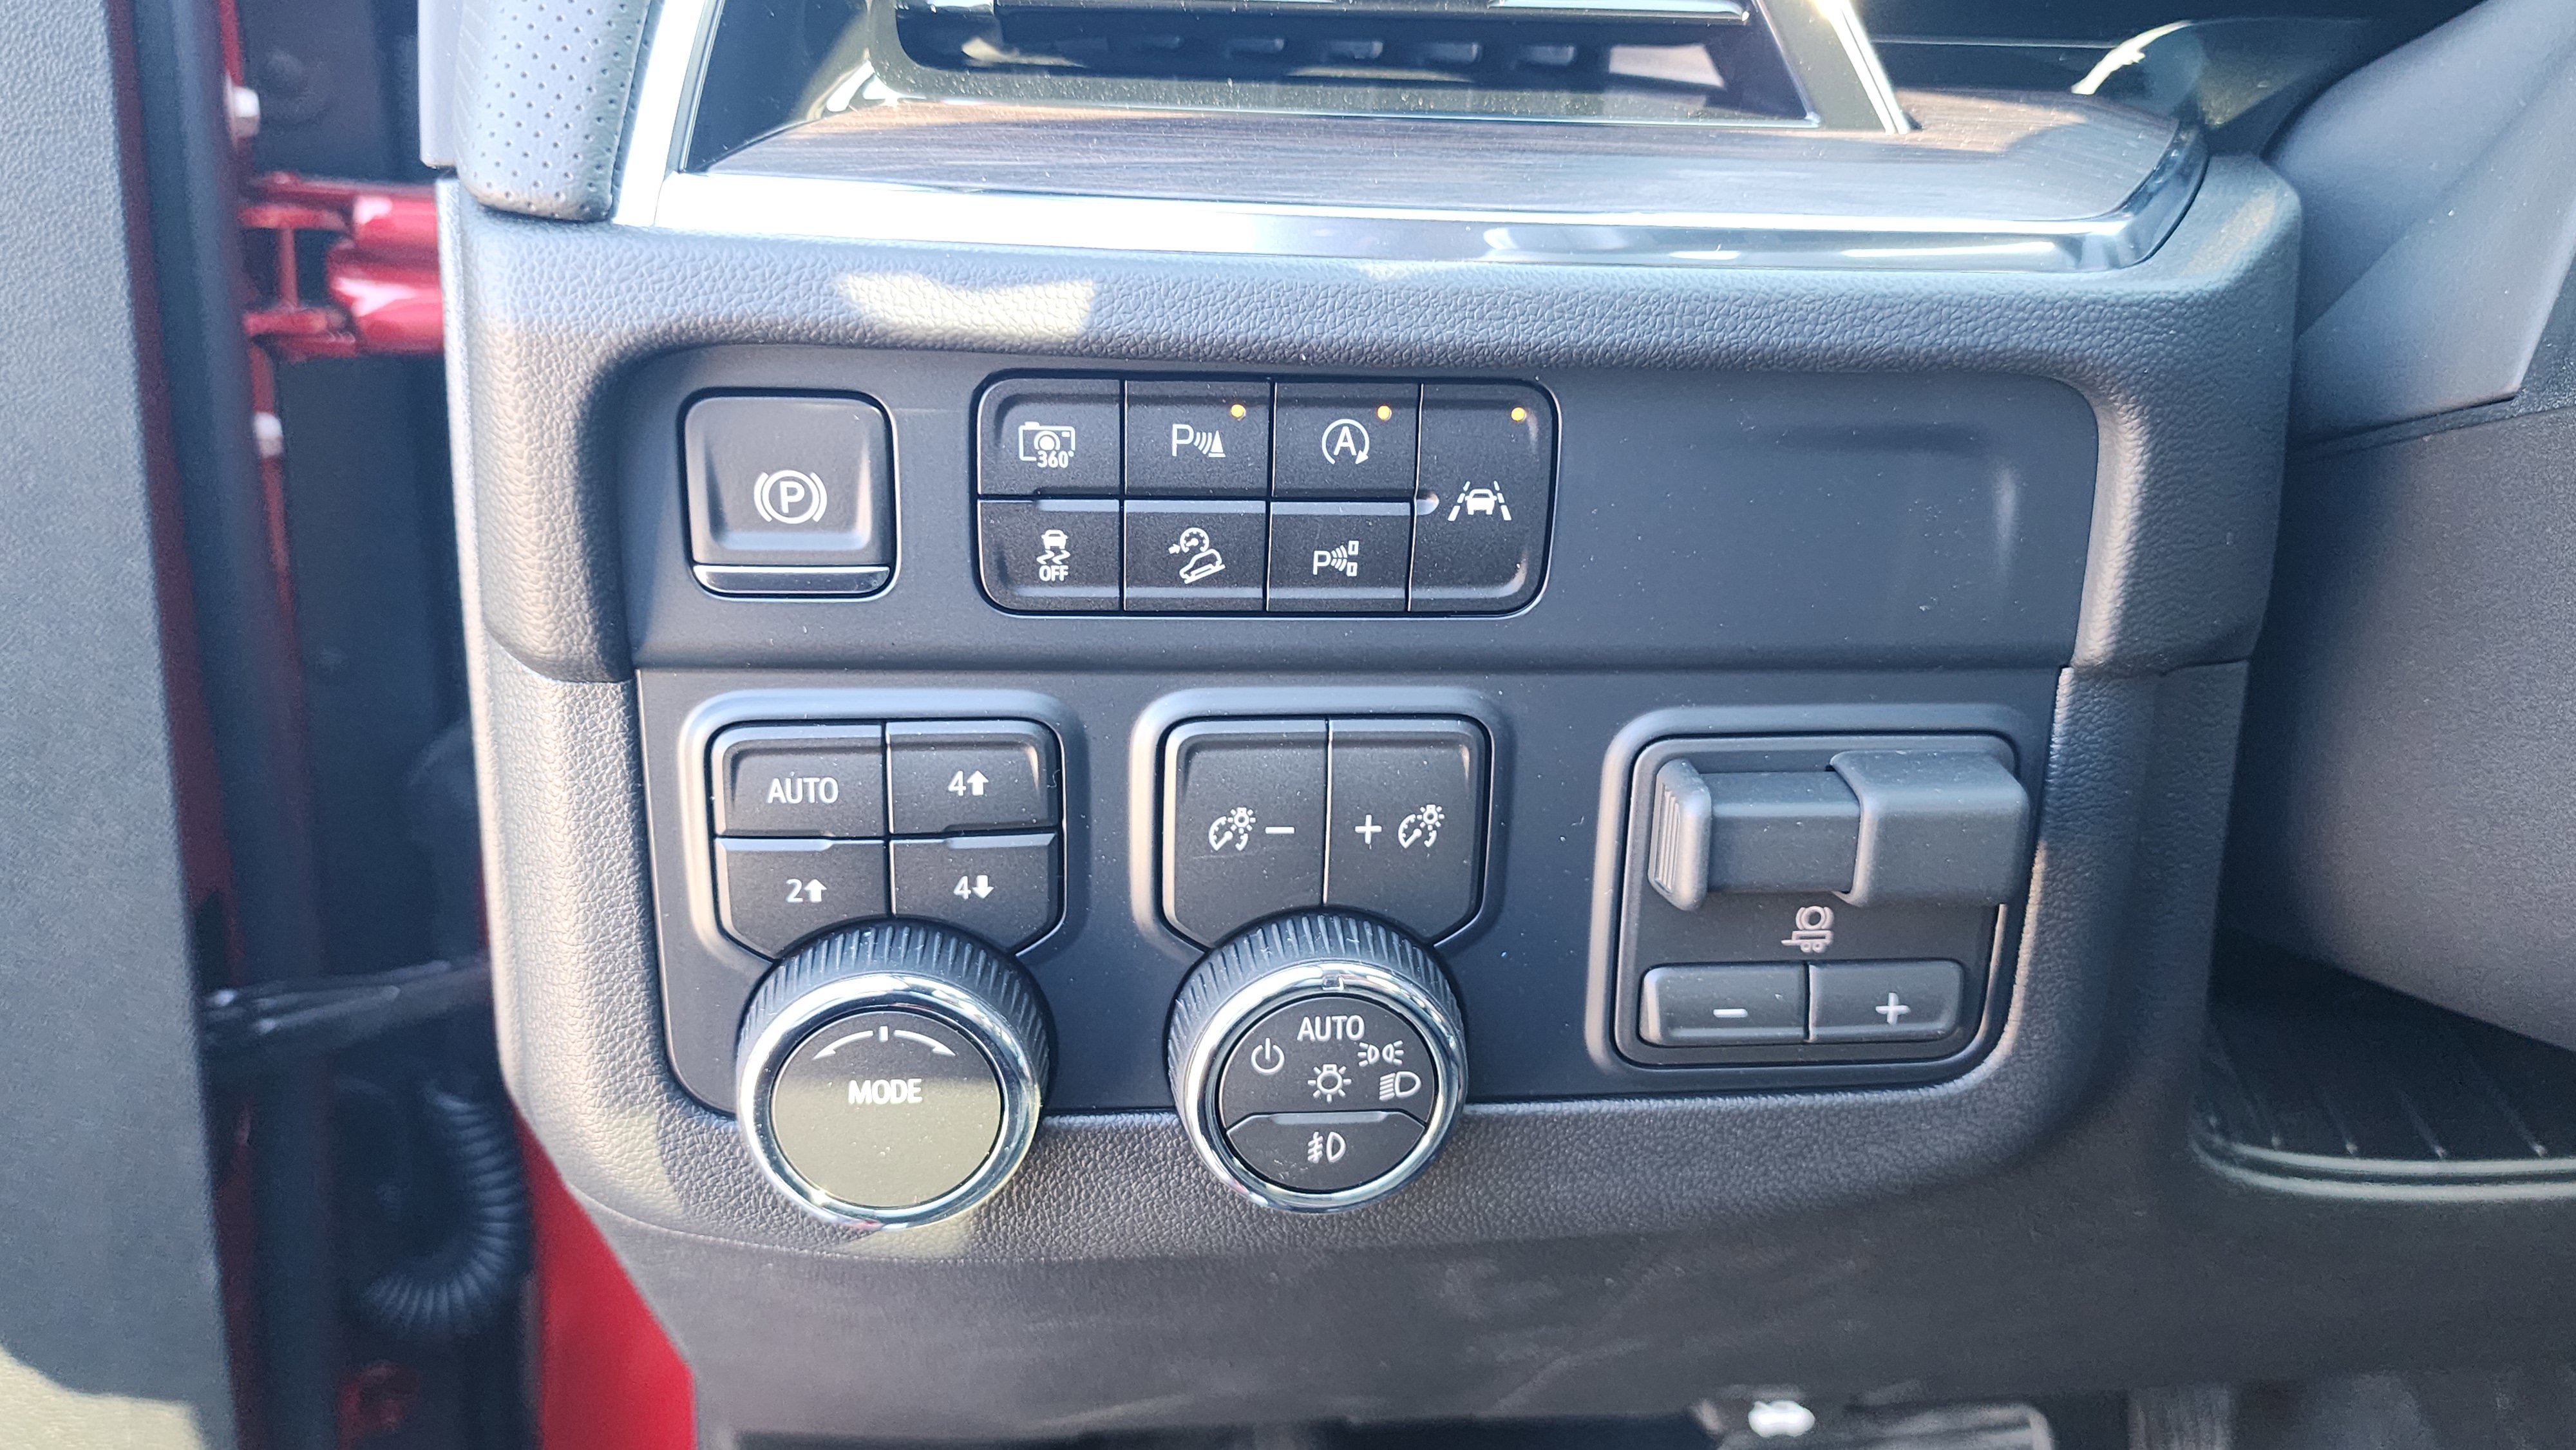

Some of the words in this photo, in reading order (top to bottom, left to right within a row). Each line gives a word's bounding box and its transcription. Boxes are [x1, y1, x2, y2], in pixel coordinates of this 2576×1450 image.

[1172, 424, 1192, 457] P
[1334, 429, 1353, 456] A
[779, 480, 806, 514] P
[1038, 565, 1069, 581] OFF
[1312, 549, 1331, 574] P
[767, 777, 839, 804] AUTO
[947, 771, 966, 796] 4
[785, 878, 804, 903] 2
[953, 876, 972, 899] 4
[1296, 1015, 1365, 1042] AUTO
[848, 1078, 923, 1105] MODE
